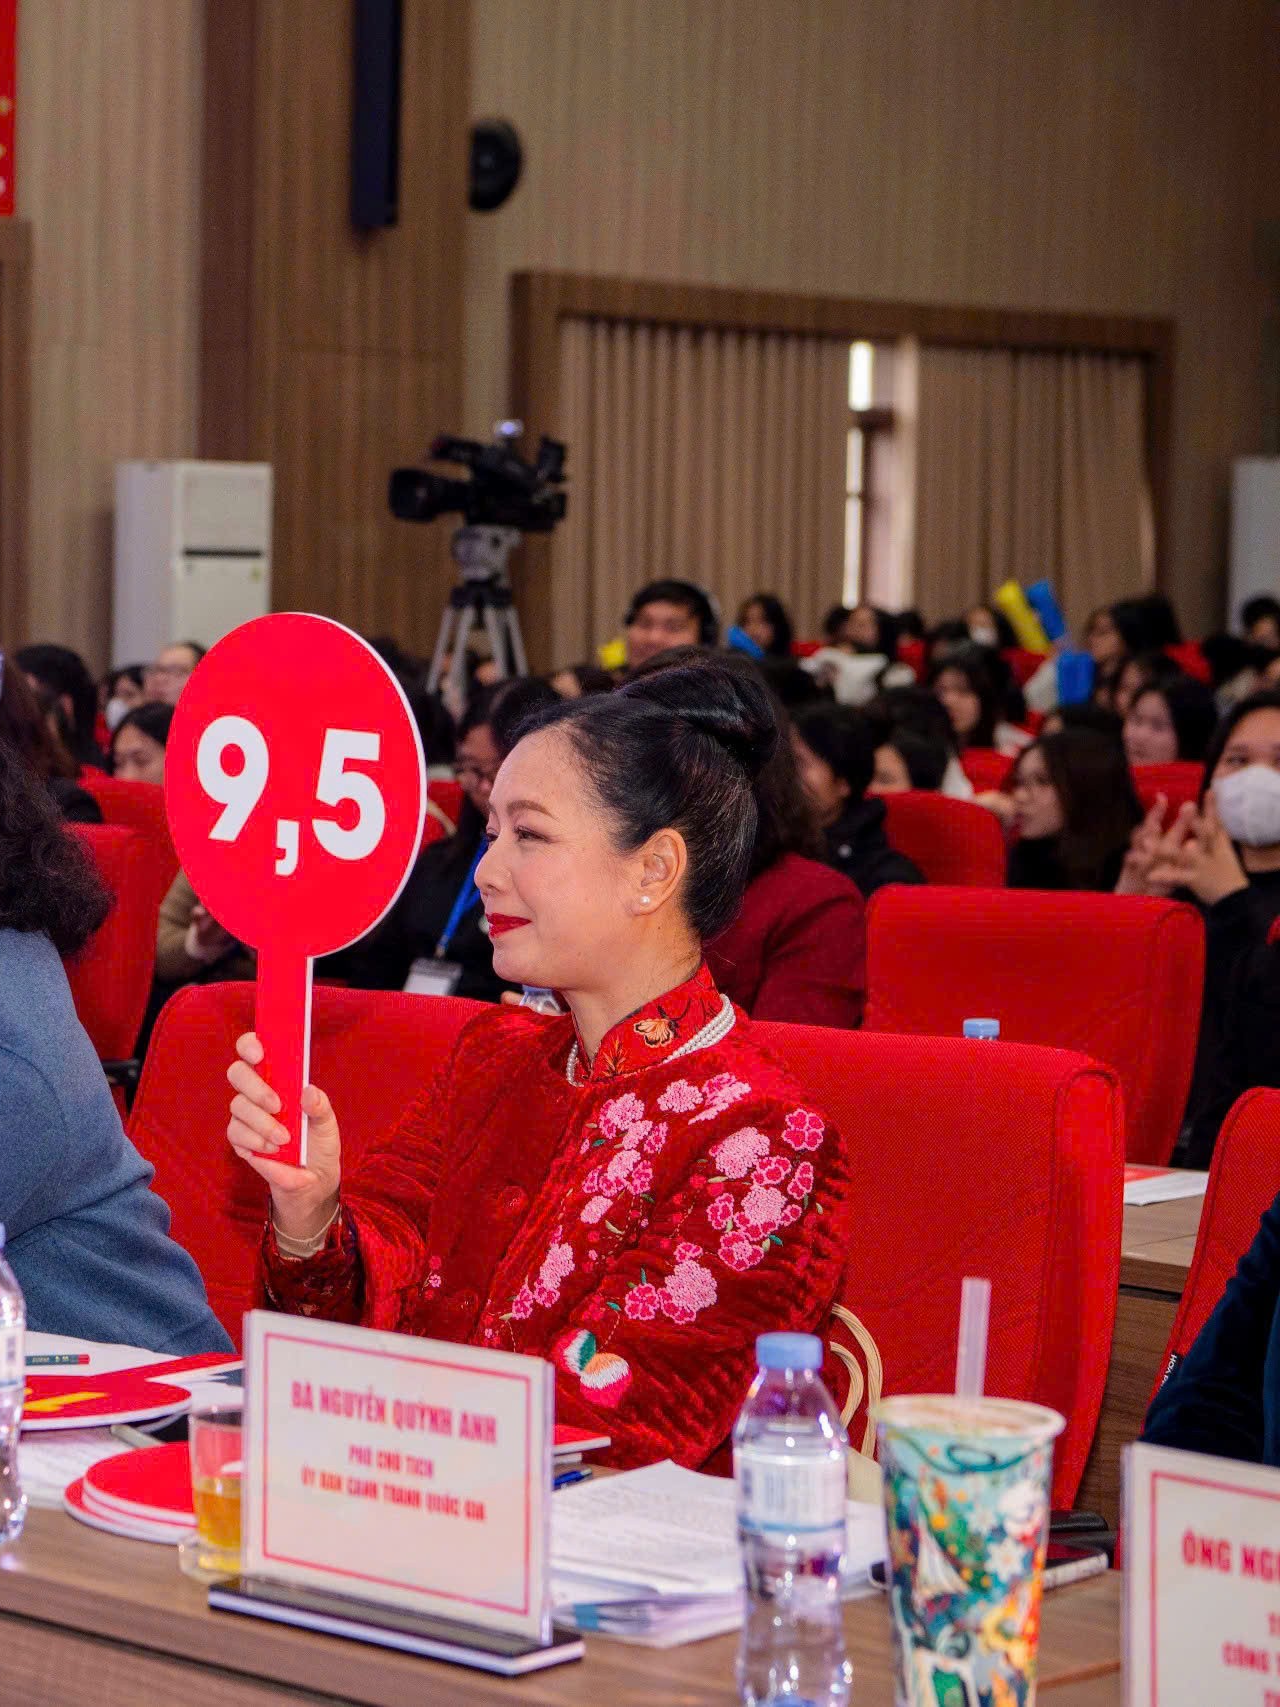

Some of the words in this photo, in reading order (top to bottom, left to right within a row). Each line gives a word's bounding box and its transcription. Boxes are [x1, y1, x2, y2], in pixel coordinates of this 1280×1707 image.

[197, 715, 386, 877] 9,5
[458, 1410, 499, 1446] ANH
[1182, 1526, 1232, 1573] ÔNG
